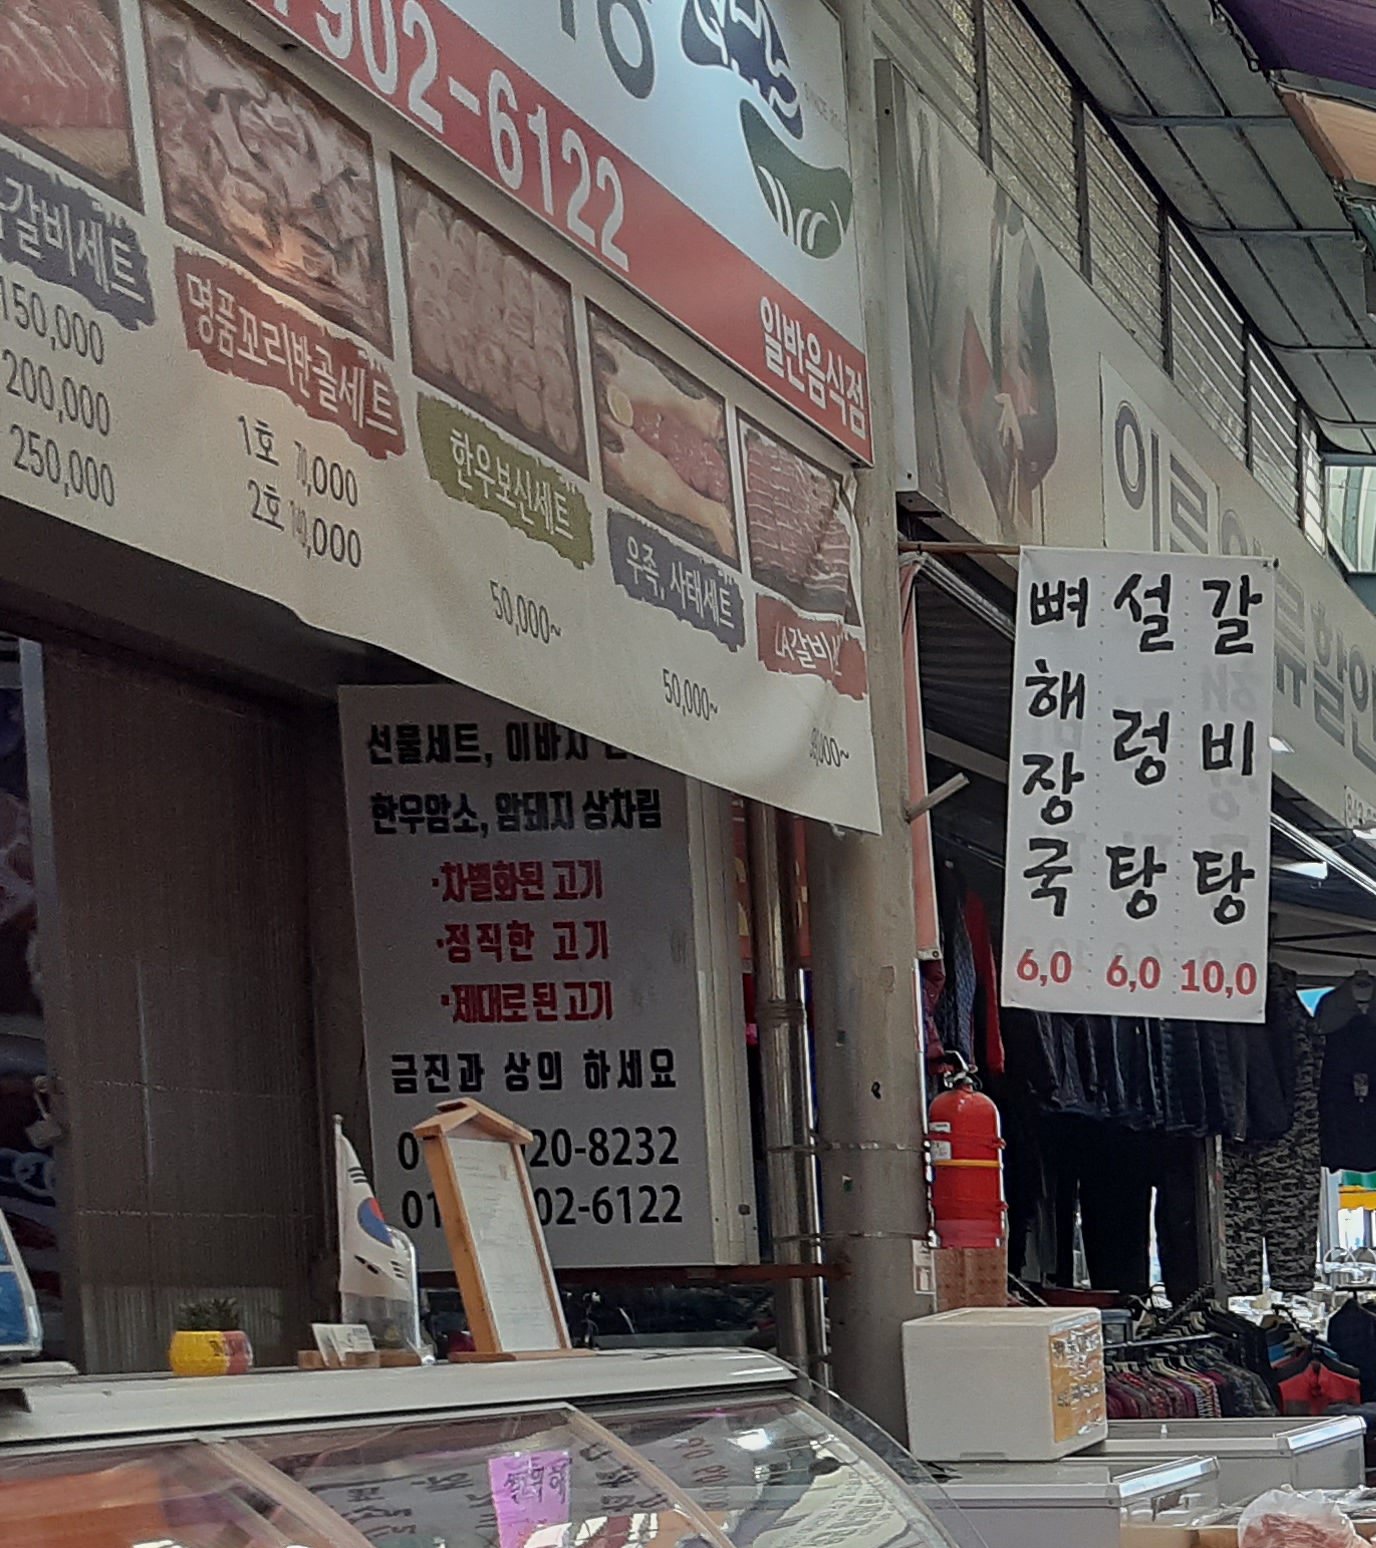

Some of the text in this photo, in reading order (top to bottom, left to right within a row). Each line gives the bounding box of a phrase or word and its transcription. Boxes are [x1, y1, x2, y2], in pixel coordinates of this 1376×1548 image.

[186, 272, 398, 435] 명품꼬리반골세트
[760, 296, 867, 440] 일반음식점
[3, 349, 111, 437] 200,000
[10, 423, 115, 507] 250,000
[238, 415, 280, 467] 1호
[248, 479, 284, 531] 2호
[451, 428, 575, 540] 한우보신세트
[670, 562, 735, 629] 사태세트
[368, 722, 493, 768] 선물세트,
[1022, 578, 1088, 917] 뼈해장국
[1107, 573, 1174, 920] 설렁탕
[1194, 574, 1262, 925] 갈비탕
[582, 787, 662, 831] 상차림
[552, 859, 604, 901] 고기
[445, 919, 610, 963] 정직한 고기
[391, 1047, 678, 1095] 금진과 상의 하세요
